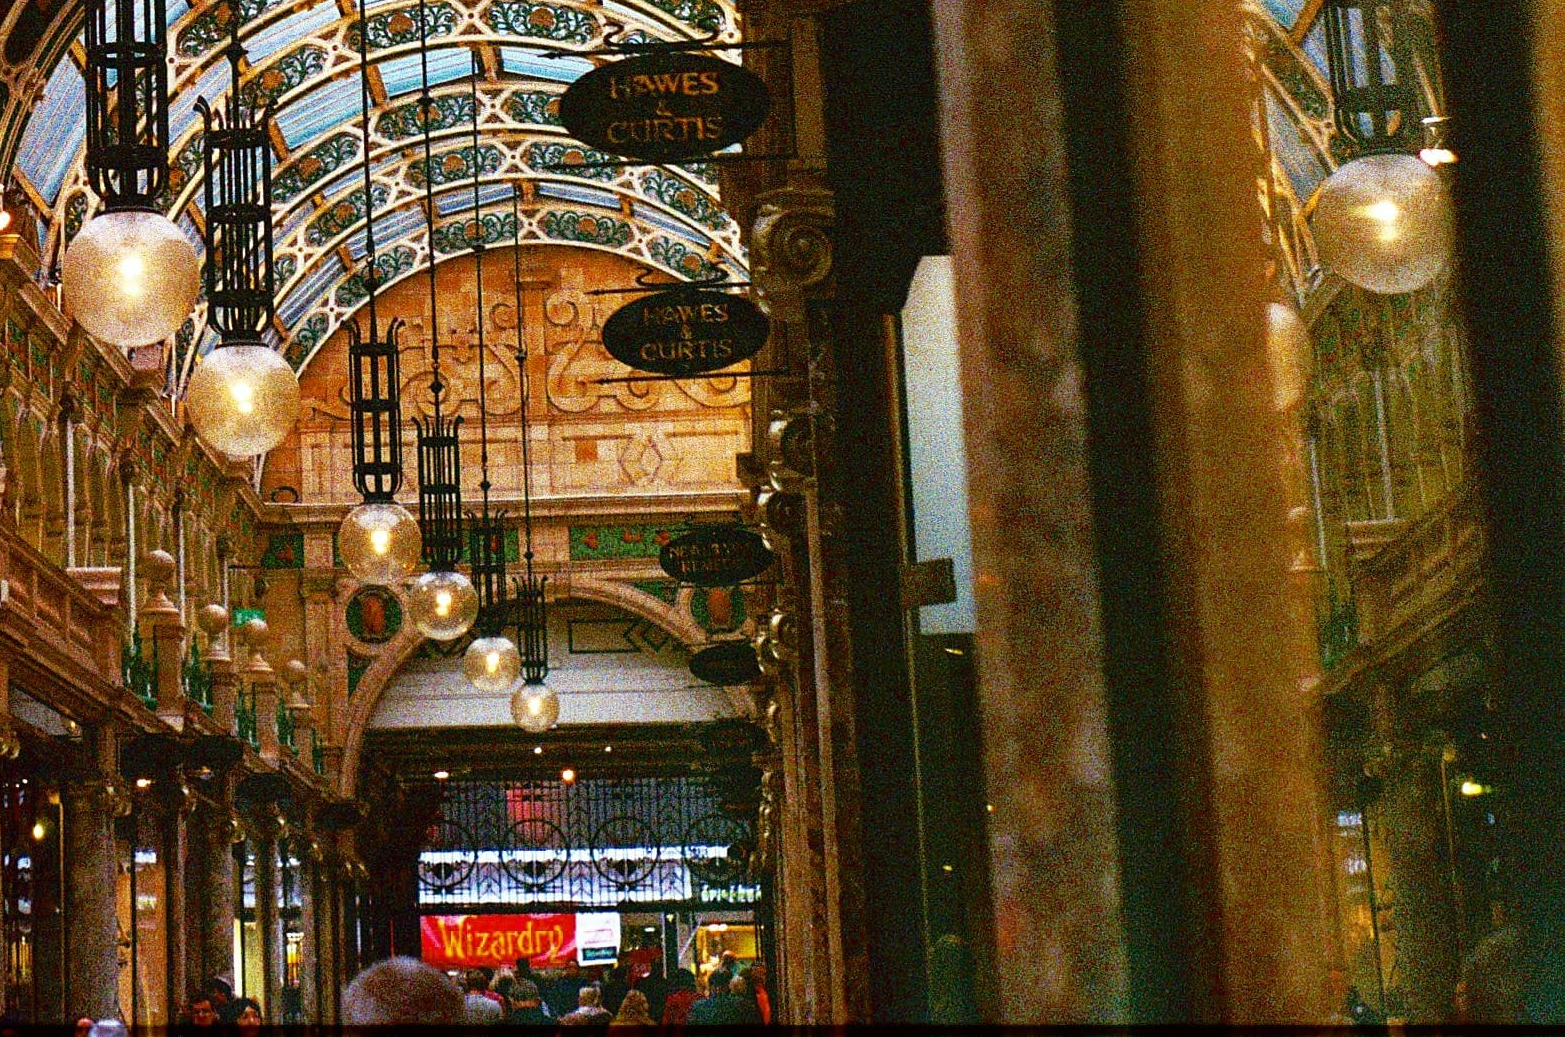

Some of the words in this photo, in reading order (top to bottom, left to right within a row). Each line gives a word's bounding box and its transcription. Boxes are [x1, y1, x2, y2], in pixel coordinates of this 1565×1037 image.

[606, 115, 724, 145] CURTIS
[639, 338, 734, 362] CURTIS
[438, 914, 564, 964] Wizardry
